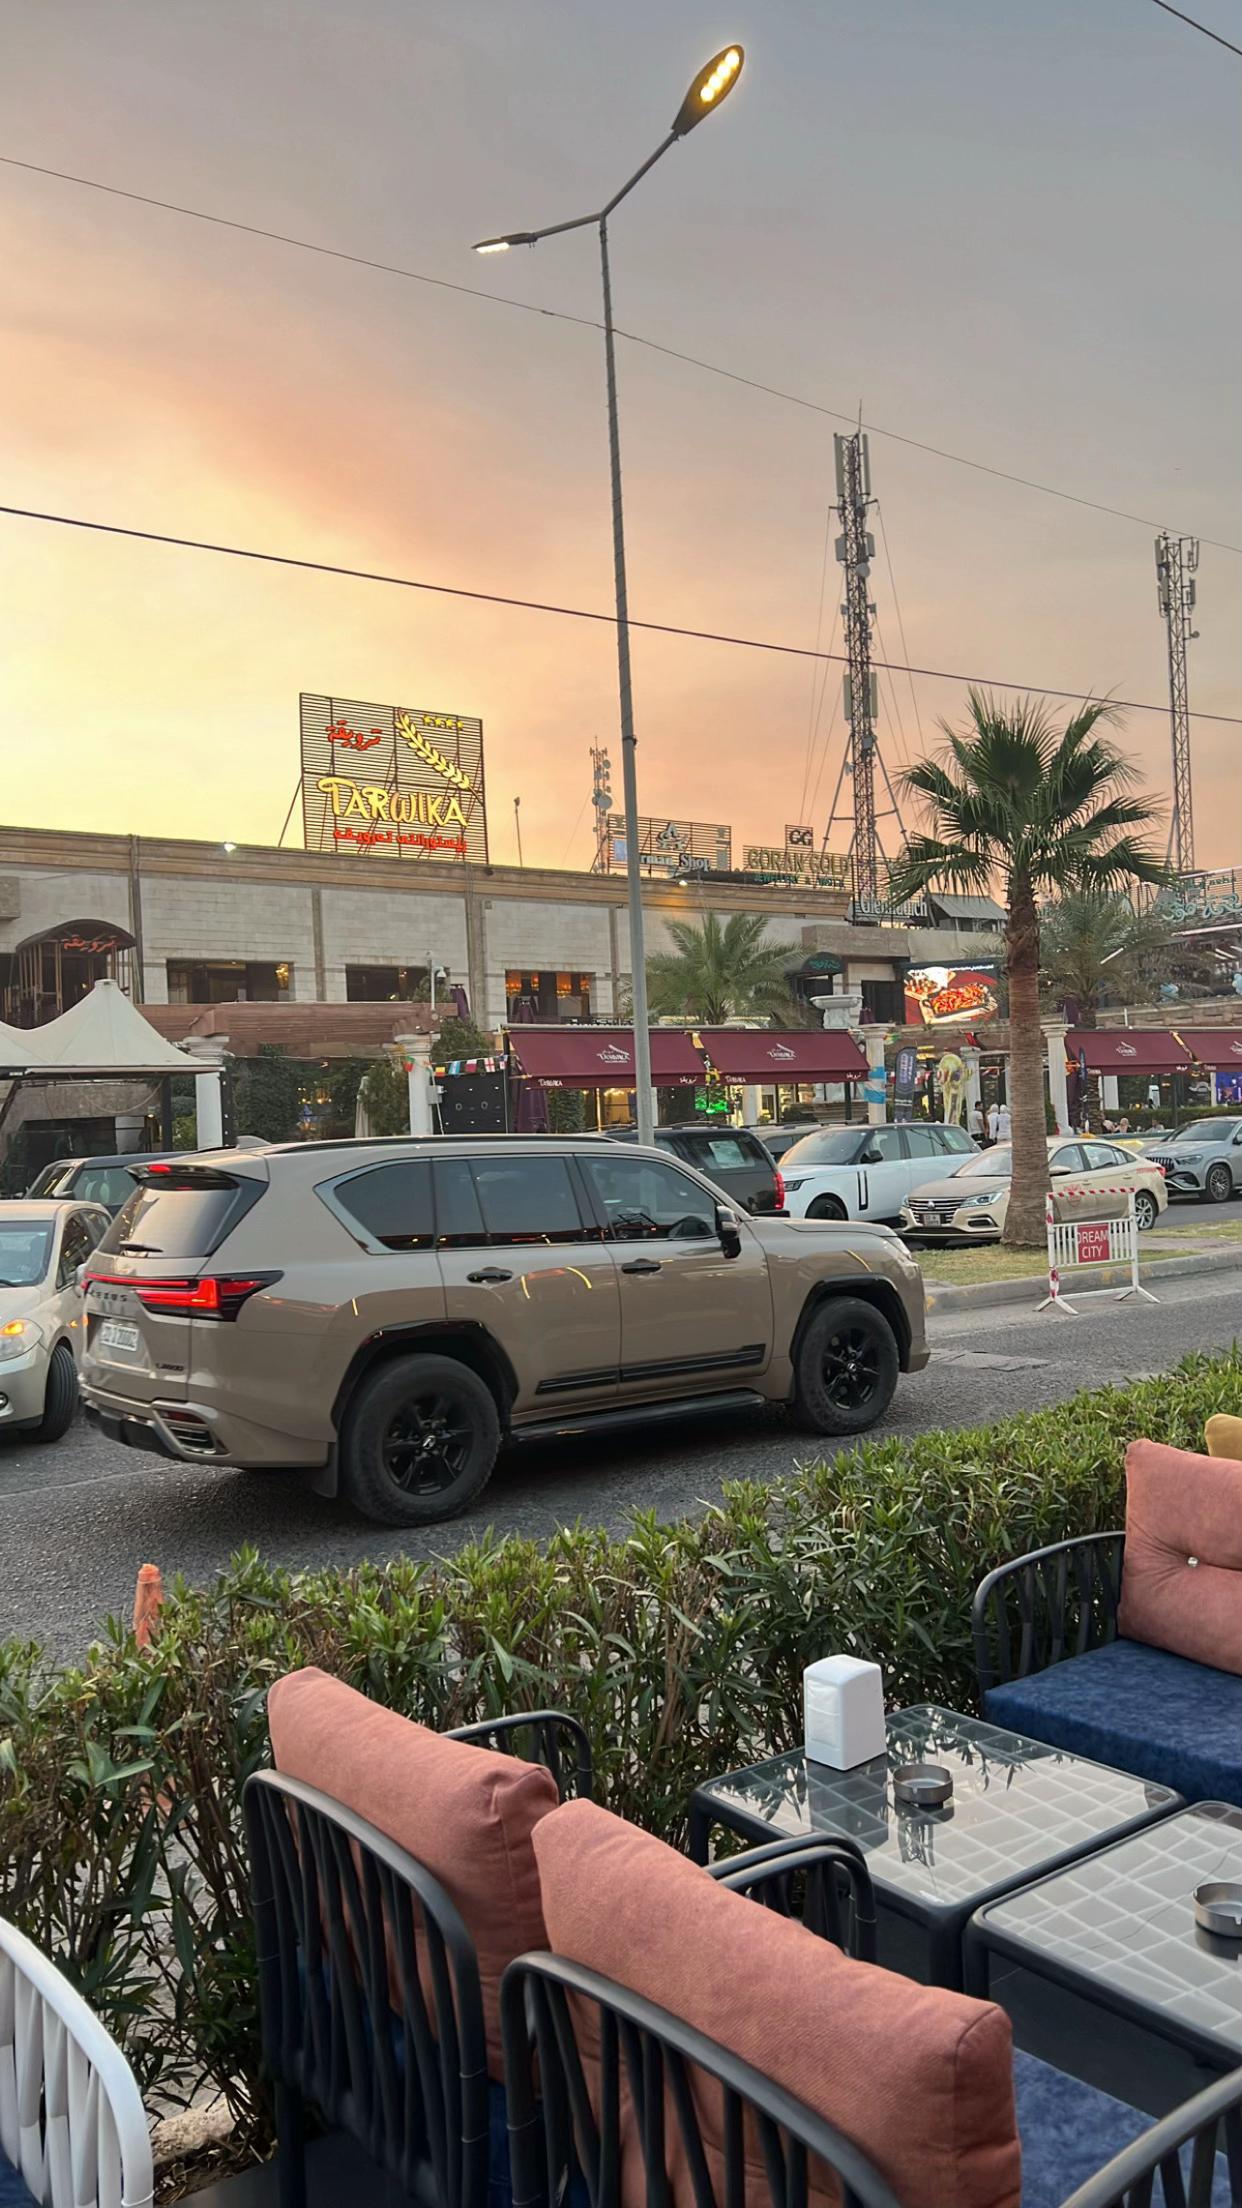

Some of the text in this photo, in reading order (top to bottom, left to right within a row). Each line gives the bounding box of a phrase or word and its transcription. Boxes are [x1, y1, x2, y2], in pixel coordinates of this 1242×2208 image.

[317, 776, 469, 827] TARWIKA
[680, 853, 710, 872] Shop
[1082, 1245, 1103, 1259] CITY
